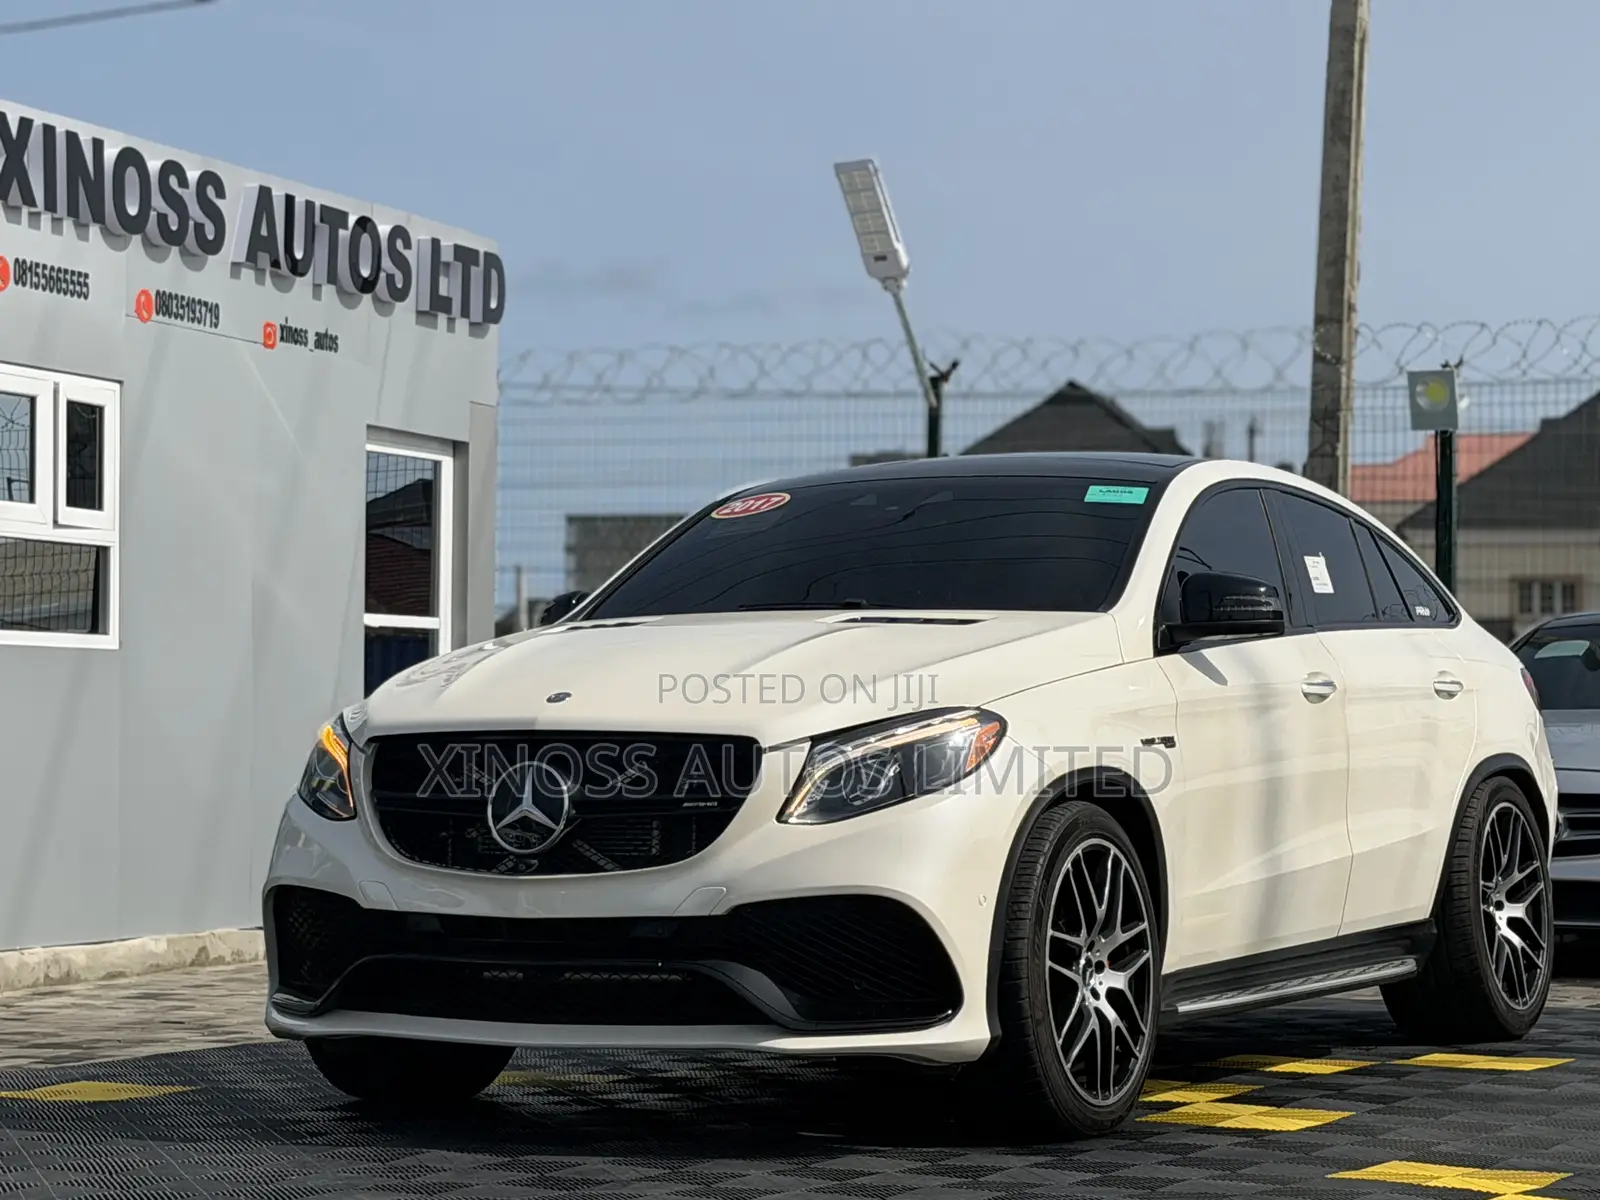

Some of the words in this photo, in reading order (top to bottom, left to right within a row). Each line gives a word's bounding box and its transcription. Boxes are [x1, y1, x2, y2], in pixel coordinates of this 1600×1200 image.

[0, 111, 226, 256] XINOSS
[246, 184, 412, 303] AUTOS
[430, 237, 506, 325] LTD
[13, 257, 90, 300] 08155665555
[155, 289, 220, 329] 08035193719
[279, 316, 339, 354] xinoss_autos
[717, 496, 786, 515] 2017
